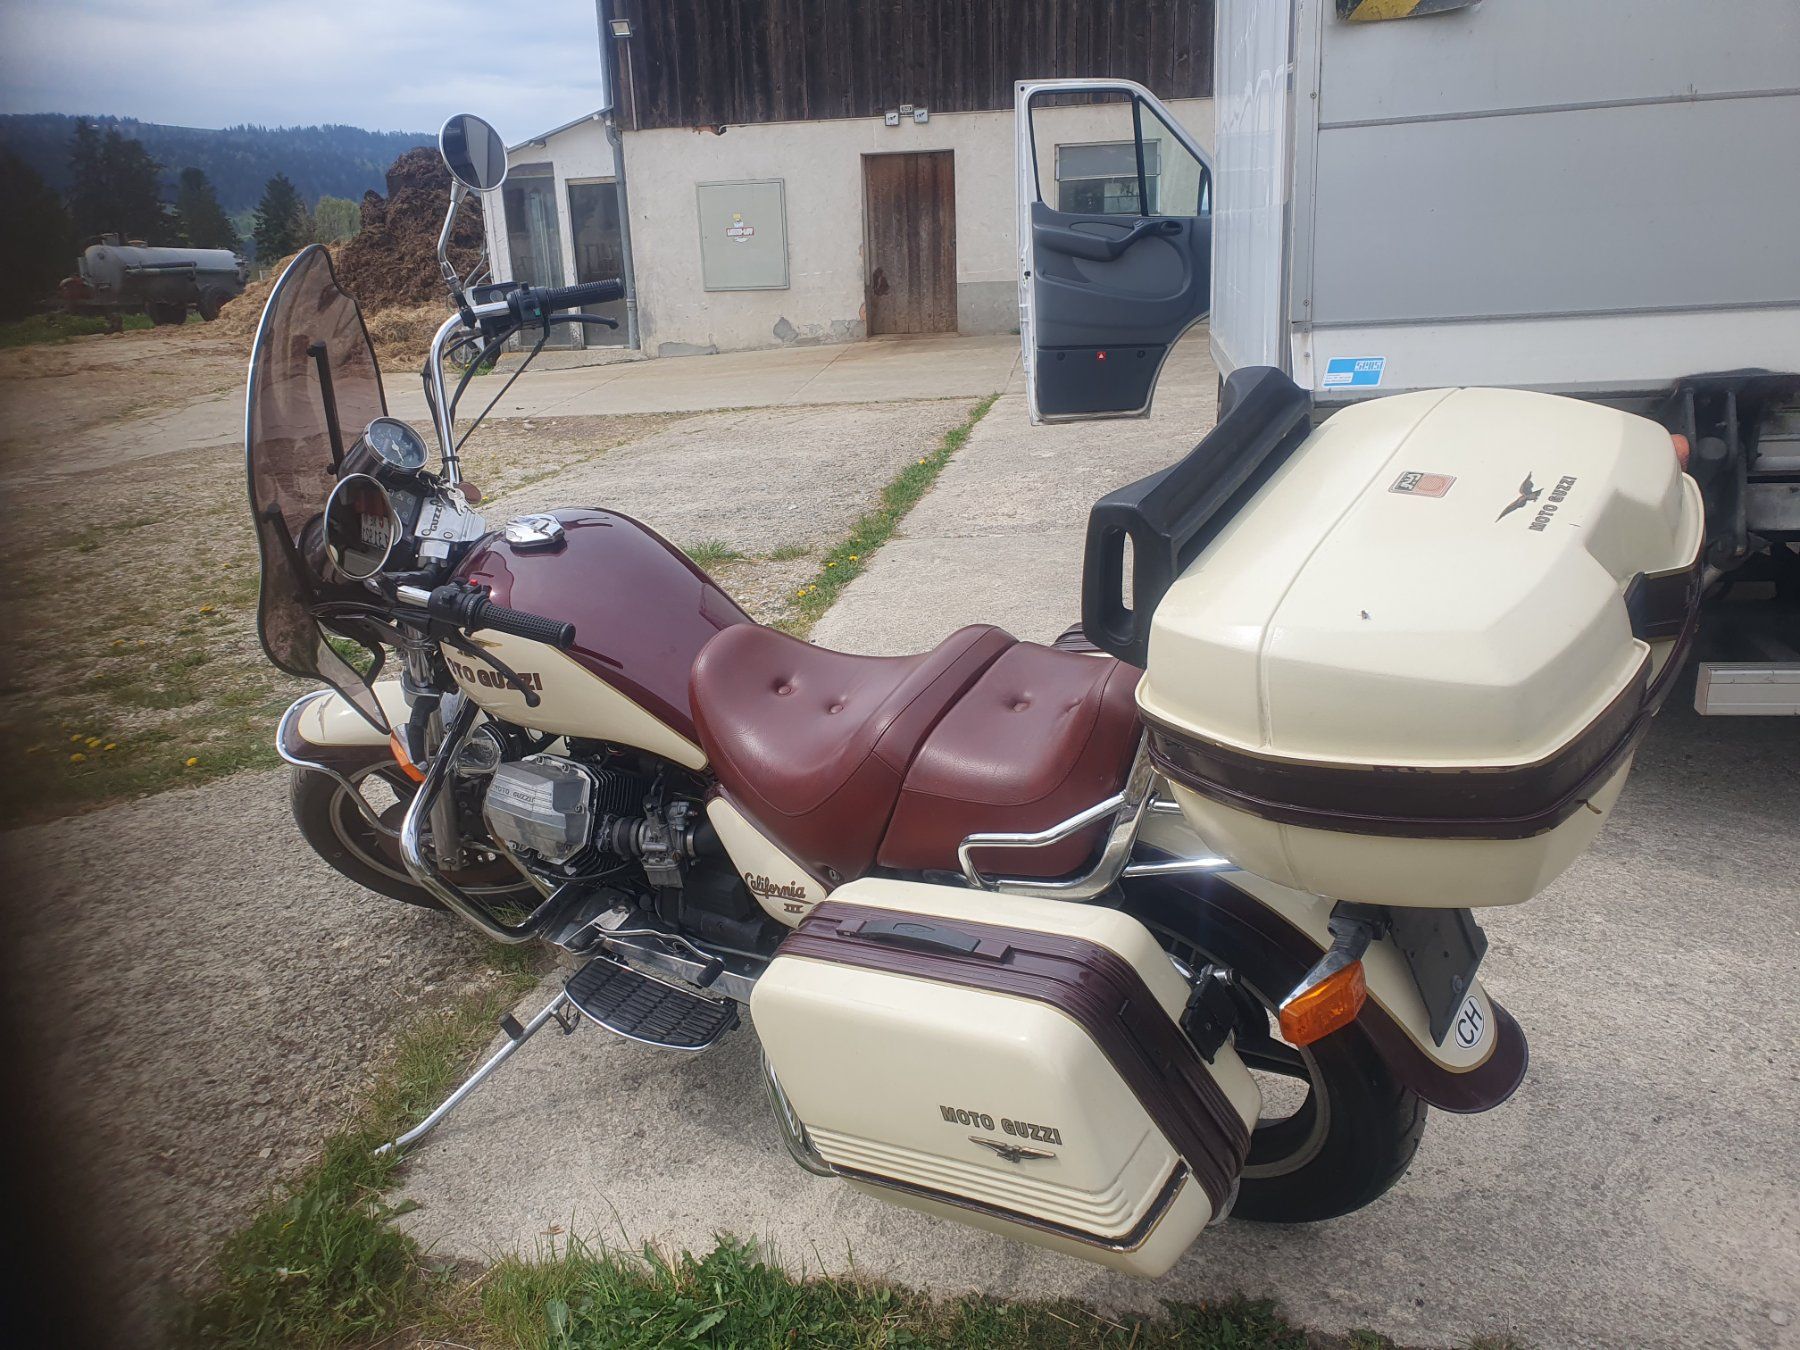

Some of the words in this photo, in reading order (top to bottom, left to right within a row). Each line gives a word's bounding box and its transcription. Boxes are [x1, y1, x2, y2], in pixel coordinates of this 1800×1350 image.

[1528, 504, 1558, 532] MOTO
[1548, 475, 1577, 503] GUZZI
[446, 656, 476, 684] OTO
[744, 871, 806, 900] California
[1457, 1000, 1483, 1045] CH
[939, 1104, 996, 1131] MOTO
[1000, 1117, 1063, 1146] GUZZI
